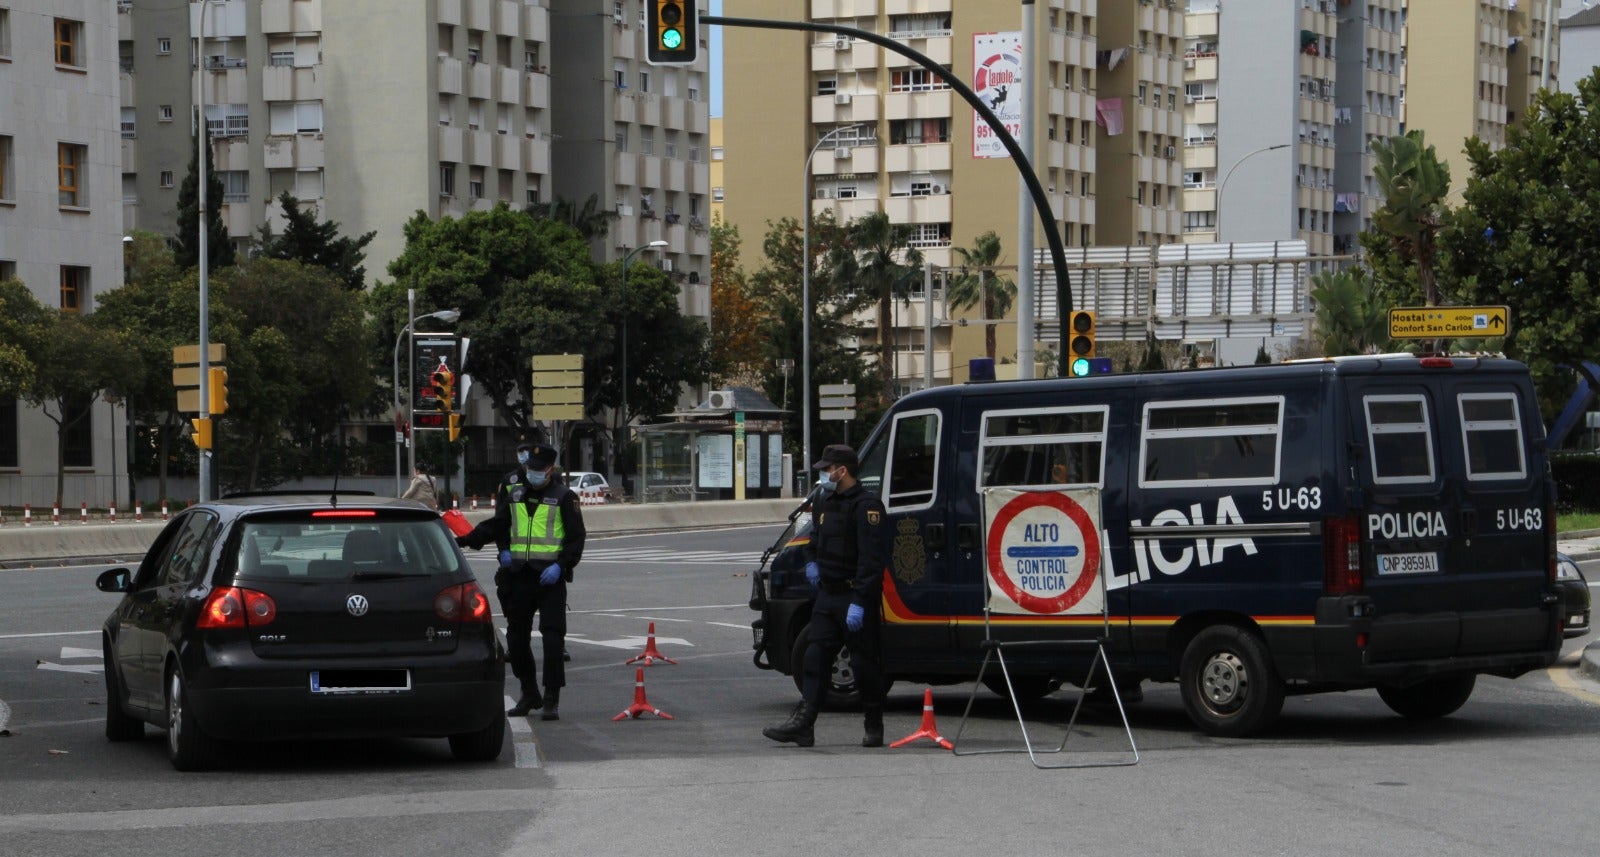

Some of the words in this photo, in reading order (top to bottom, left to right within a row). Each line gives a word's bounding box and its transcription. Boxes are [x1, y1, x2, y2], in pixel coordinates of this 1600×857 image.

[1392, 313, 1425, 322] Hostal
[1392, 324, 1424, 332] Confort
[1445, 323, 1472, 331] Carlos
[1262, 490, 1273, 511] 5
[1278, 487, 1321, 510] U-63
[1368, 511, 1448, 539] POLICIA
[1496, 509, 1504, 530] 5
[1508, 507, 1542, 530] U-63
[1024, 523, 1059, 542] ALTO
[1103, 495, 1258, 591] LICIA
[1017, 559, 1068, 574] CONTROL
[1021, 576, 1066, 590] POLICIA
